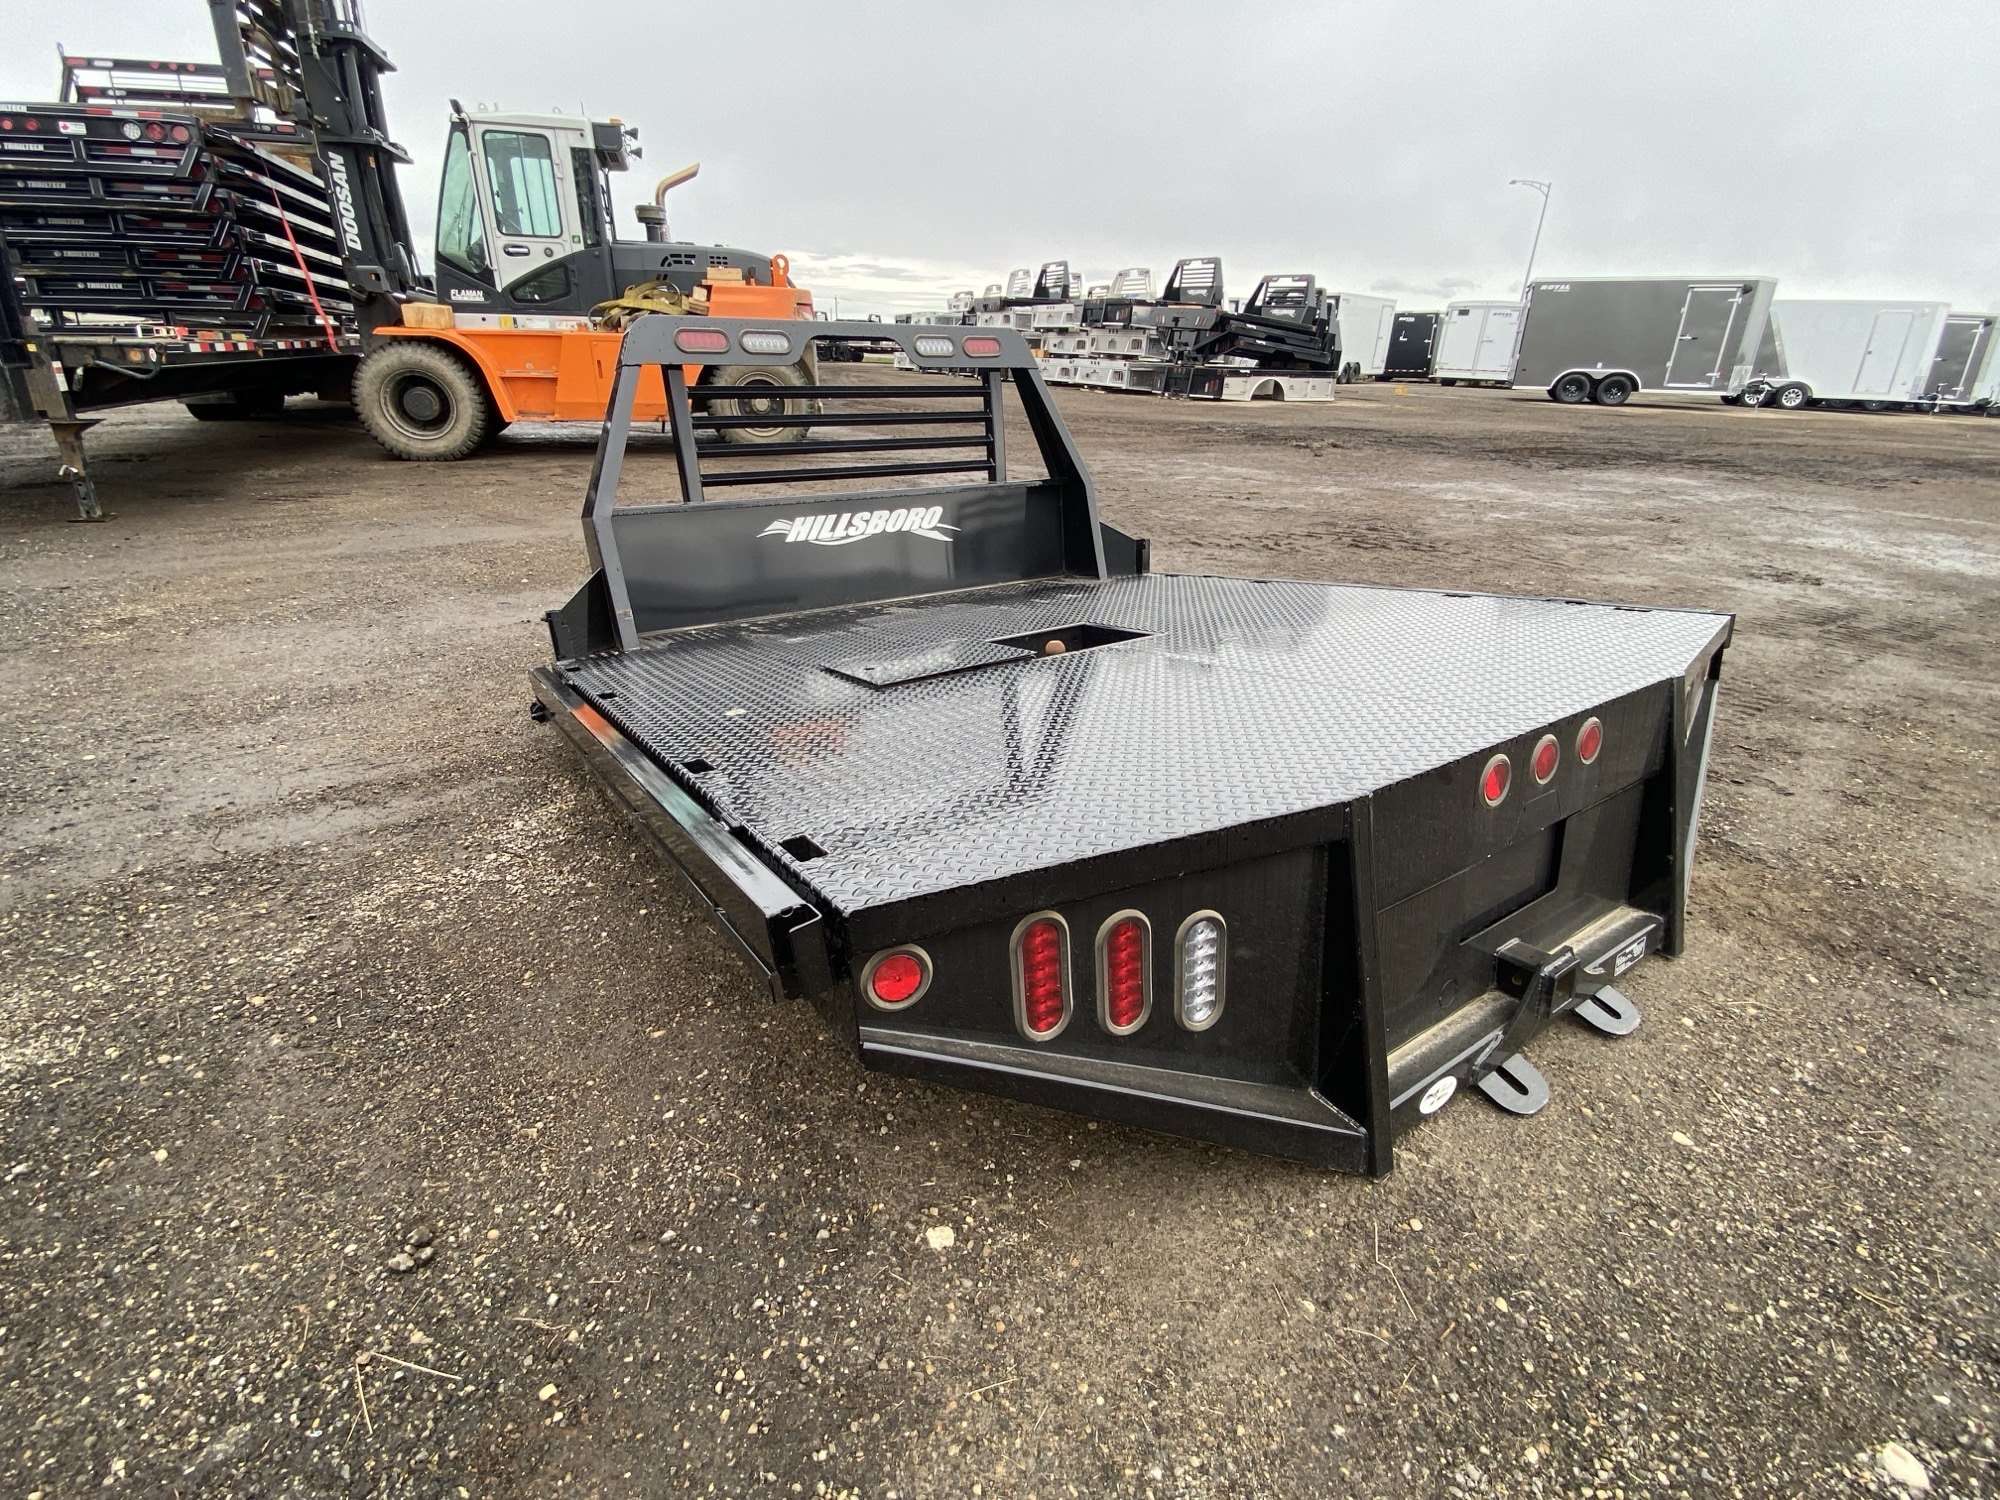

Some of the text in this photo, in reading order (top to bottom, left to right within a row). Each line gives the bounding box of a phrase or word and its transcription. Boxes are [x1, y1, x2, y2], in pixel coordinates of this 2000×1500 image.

[328, 151, 362, 251] DOOSAN
[450, 289, 483, 298] FLAMAN
[785, 506, 943, 542] HILLSBORO
